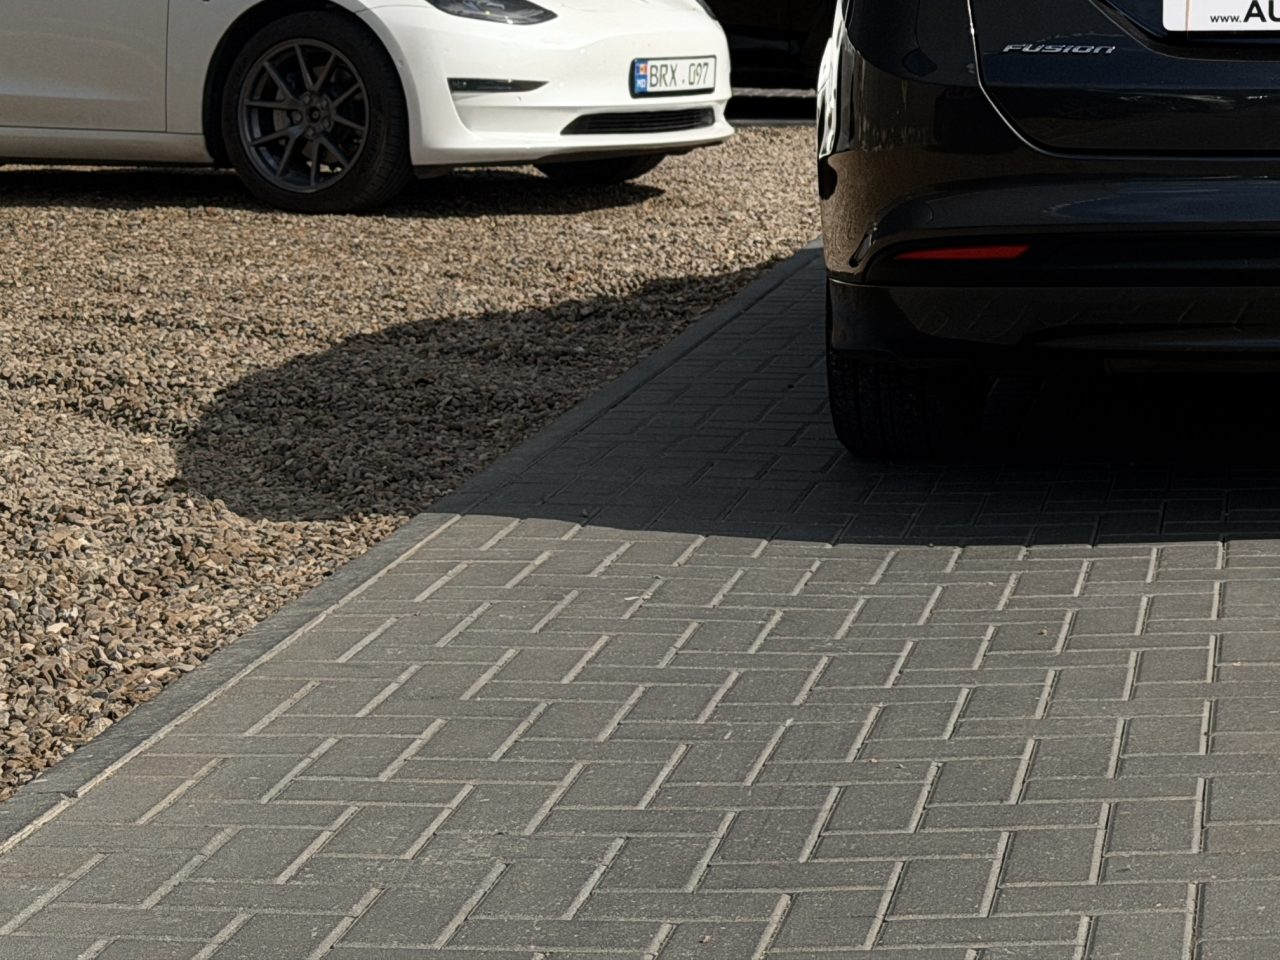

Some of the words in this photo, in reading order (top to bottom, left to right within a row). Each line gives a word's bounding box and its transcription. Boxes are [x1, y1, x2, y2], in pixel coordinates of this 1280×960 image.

[1003, 43, 1115, 54] FUSION
[649, 64, 678, 88] BRX
[688, 62, 709, 86] 097
